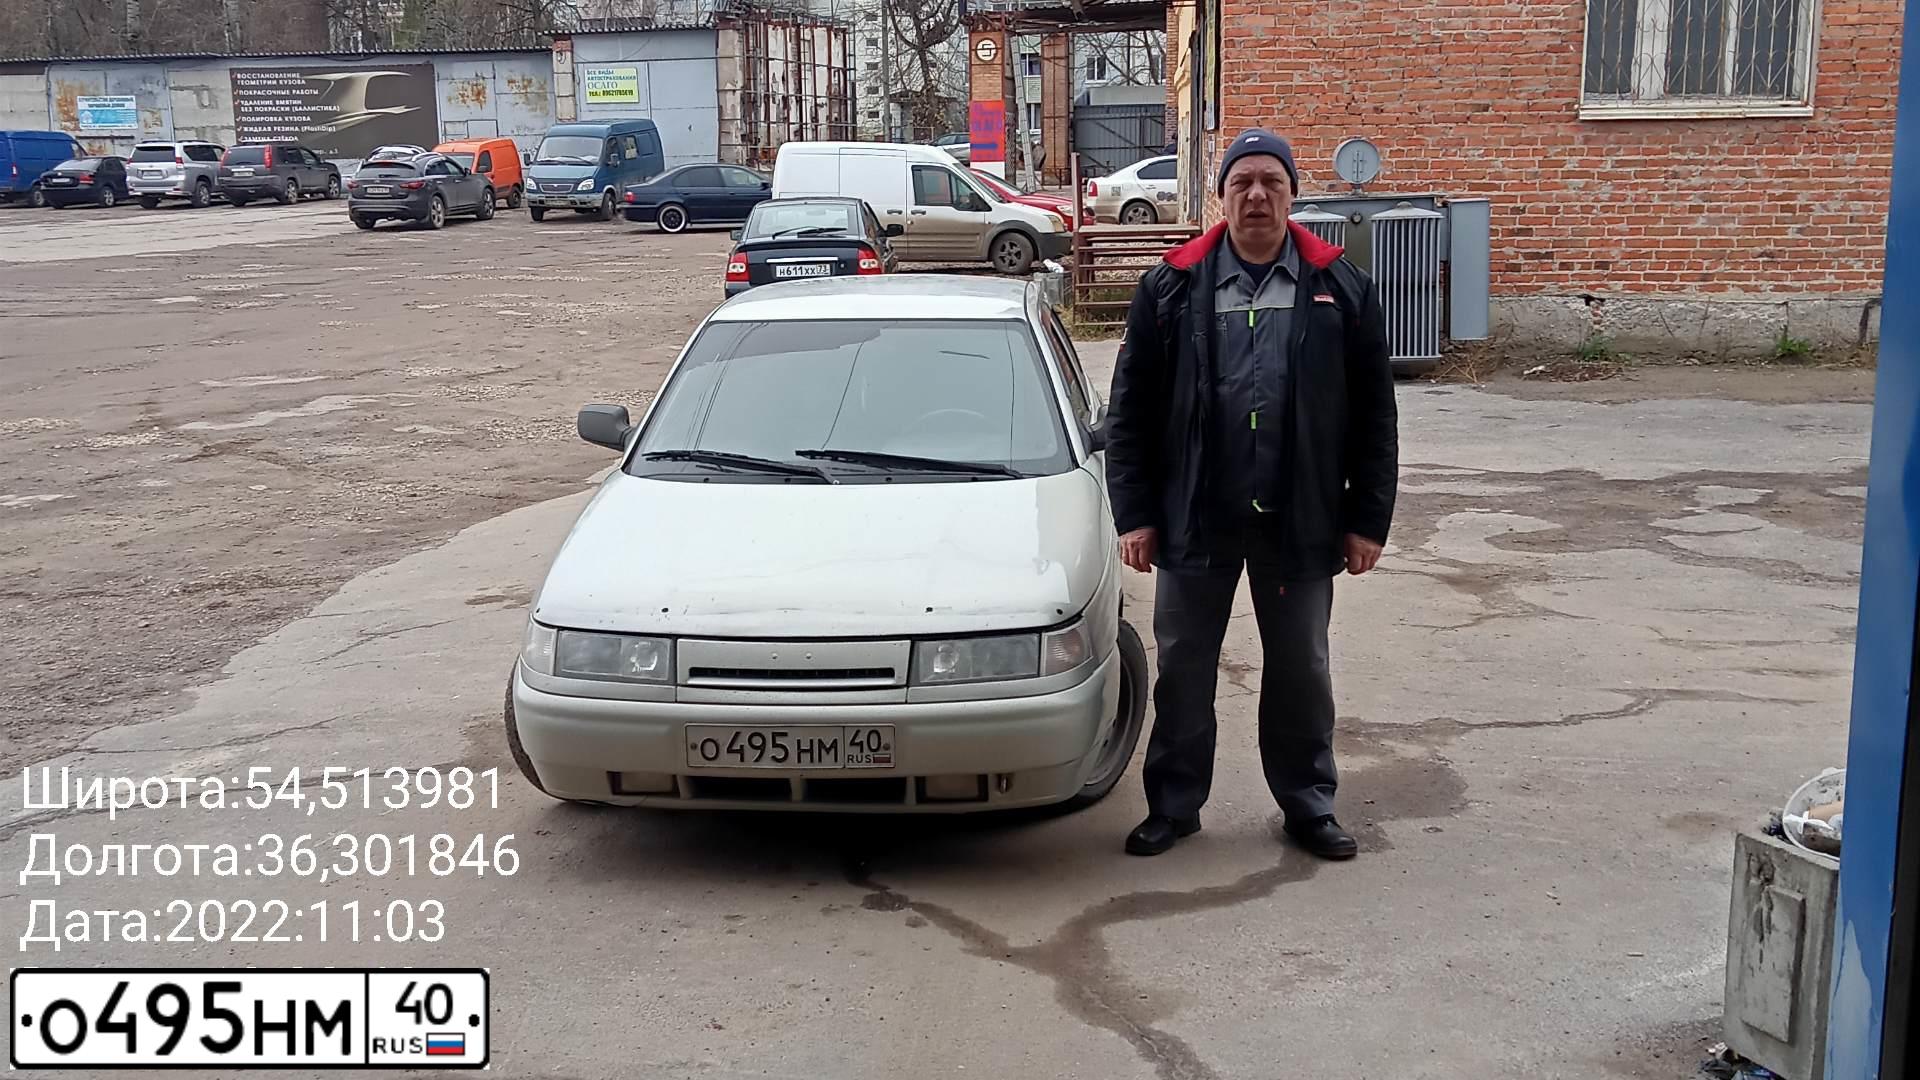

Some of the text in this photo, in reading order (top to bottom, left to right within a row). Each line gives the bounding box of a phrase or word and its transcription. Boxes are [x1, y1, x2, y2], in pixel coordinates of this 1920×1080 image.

[587, 81, 618, 89] ОСАГО
[700, 729, 882, 764] О495НМ 40
[847, 754, 872, 764] RUS
